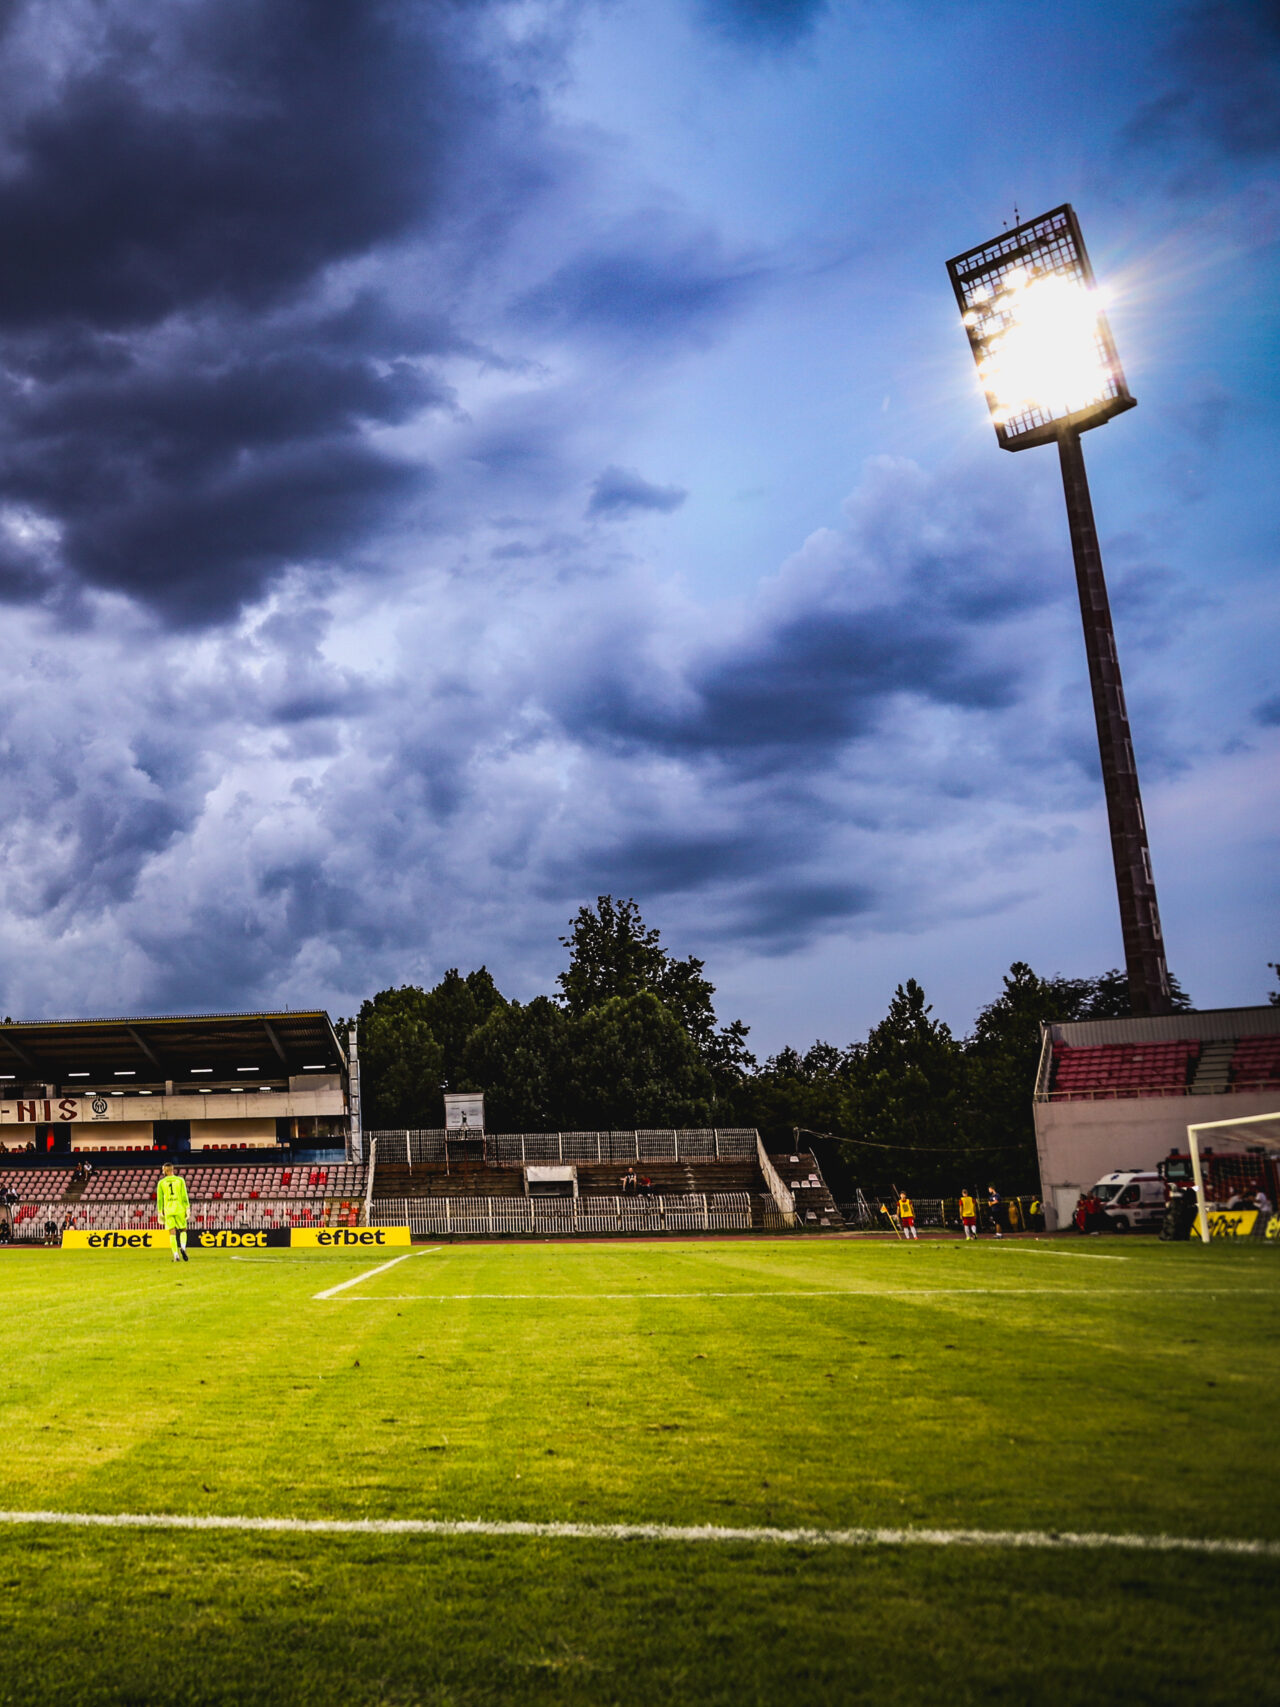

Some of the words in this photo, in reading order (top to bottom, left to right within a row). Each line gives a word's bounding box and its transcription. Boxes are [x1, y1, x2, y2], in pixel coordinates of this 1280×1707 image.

[87, 1232, 152, 1248] efbet
[199, 1231, 267, 1247] efbet
[316, 1229, 385, 1245] efbet
